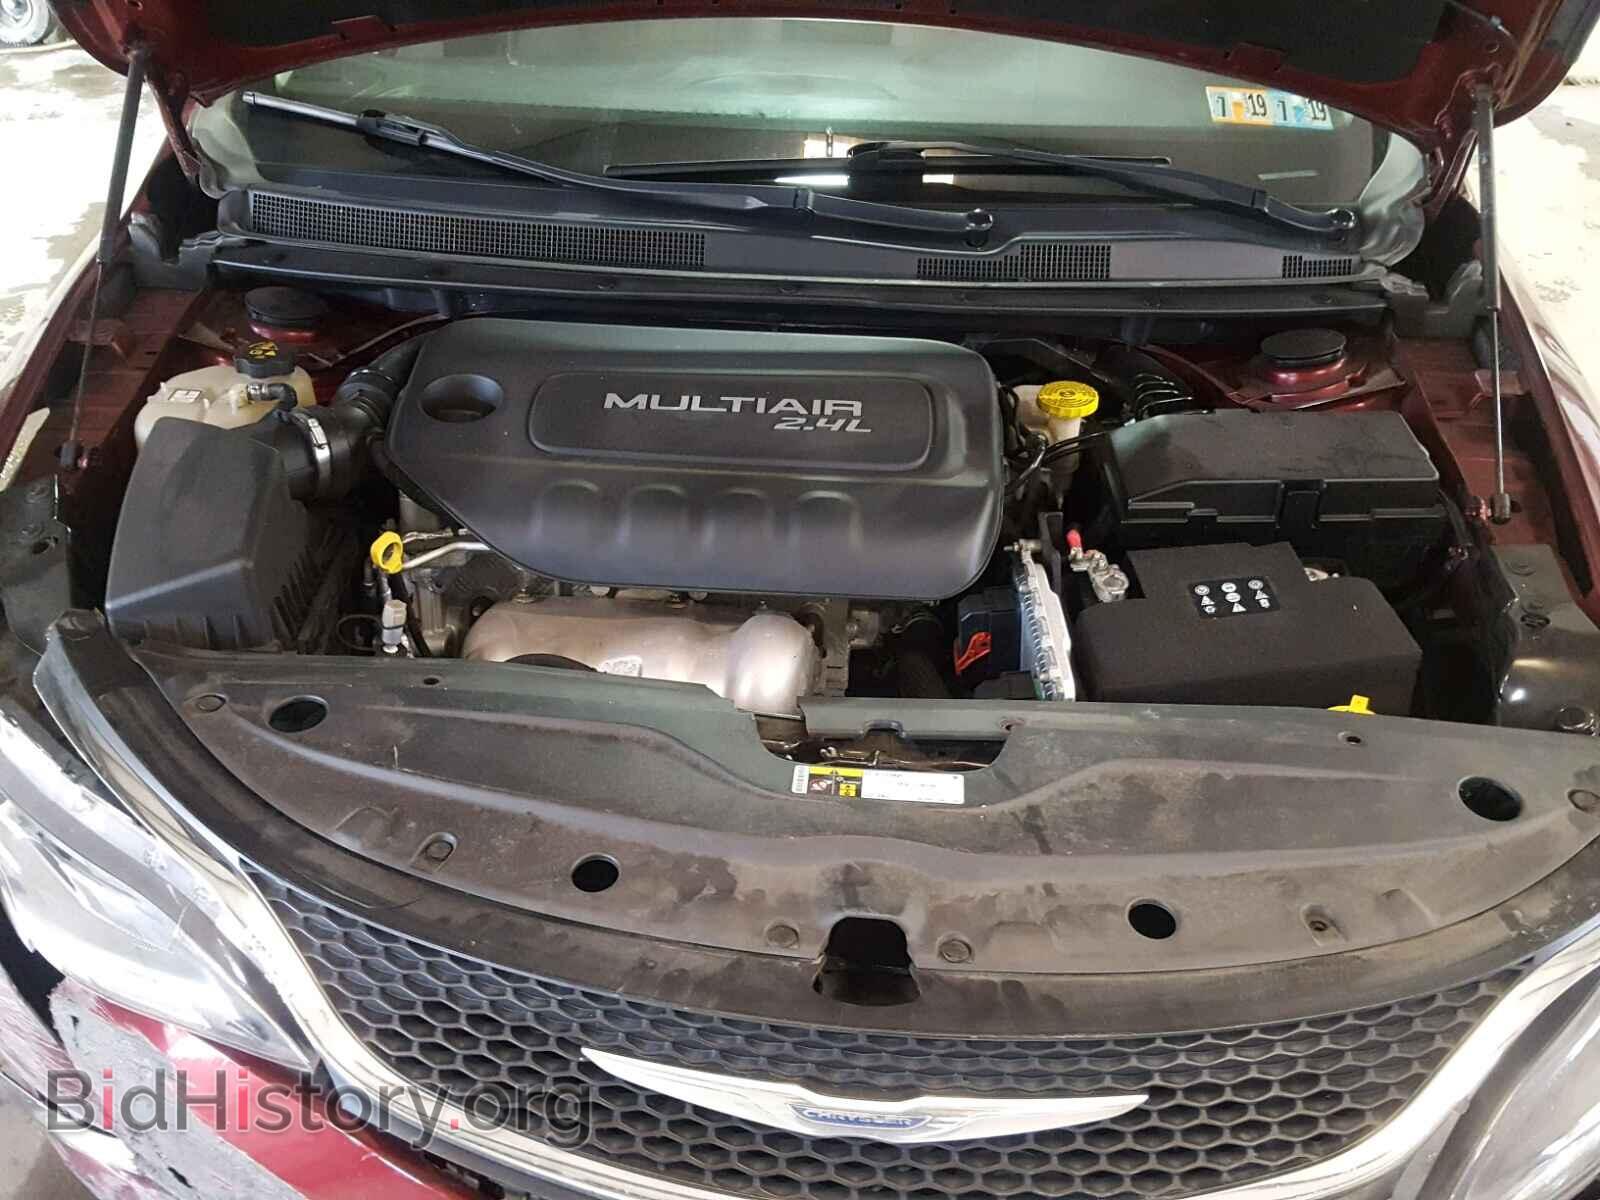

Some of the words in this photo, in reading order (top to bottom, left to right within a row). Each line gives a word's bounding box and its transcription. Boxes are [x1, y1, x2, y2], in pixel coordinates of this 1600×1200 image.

[1248, 93, 1267, 116] 19
[1308, 99, 1327, 121] 19
[603, 392, 863, 417] MULTIAIR
[774, 417, 872, 433] 2.4L
